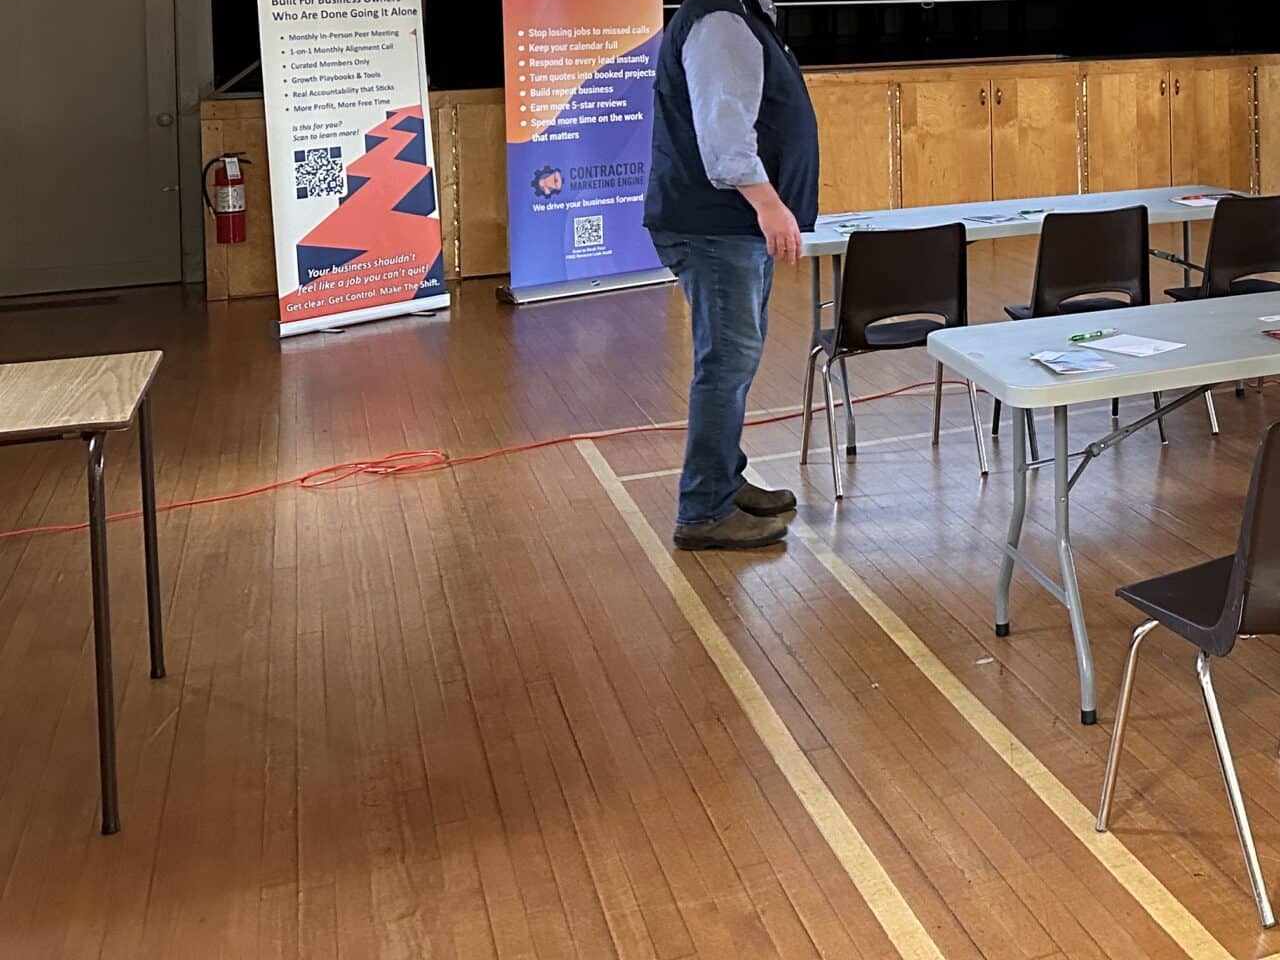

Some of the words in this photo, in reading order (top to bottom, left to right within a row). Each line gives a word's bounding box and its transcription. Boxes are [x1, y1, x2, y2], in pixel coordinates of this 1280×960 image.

[273, 11, 298, 21] Who
[301, 11, 318, 19] Are
[321, 10, 348, 19] Done
[351, 9, 379, 19] Going
[382, 8, 389, 17] It
[391, 7, 417, 16] Alone
[528, 29, 547, 39] Stop
[549, 28, 572, 37] losing
[574, 27, 591, 38] jobs
[603, 26, 631, 34] missed
[632, 25, 650, 34] calls
[346, 45, 380, 53] Alignment
[529, 44, 549, 54] Keep
[550, 44, 568, 53] your
[569, 42, 603, 51] calendar
[605, 41, 618, 49] full
[291, 62, 317, 70] Curated
[530, 58, 563, 68] Respond
[565, 58, 573, 66] to
[575, 57, 597, 67] every
[598, 56, 615, 65] lead
[617, 54, 649, 65] instantly
[320, 74, 354, 82] Playbooks
[530, 74, 548, 82] Turn
[549, 73, 575, 82] quotes
[578, 71, 593, 80] into
[595, 70, 623, 80] booked
[625, 69, 656, 79] projects
[310, 88, 359, 97] Accountability
[530, 88, 550, 97] Build
[552, 88, 577, 97] repeat
[578, 85, 614, 94] business
[531, 104, 549, 112] Earn
[550, 102, 570, 111] more
[572, 101, 595, 110] 5-star
[597, 99, 627, 109] reviews
[301, 124, 312, 132] this
[313, 122, 327, 132] for
[328, 121, 343, 130] you?
[531, 118, 556, 128] Spend
[558, 118, 577, 126] more
[579, 115, 596, 125] time
[610, 114, 623, 122] the
[624, 112, 643, 121] work
[293, 134, 309, 142] Scan
[319, 131, 338, 140] learn
[339, 129, 360, 138] more!
[532, 133, 548, 142] that
[550, 132, 579, 141] matters
[570, 162, 644, 180] CONTRACTOR
[570, 178, 616, 191] MARKETING
[618, 176, 644, 186] ENGINE
[533, 204, 545, 212] We
[547, 202, 564, 210] drive
[566, 202, 582, 211] your
[583, 198, 614, 208] business
[616, 194, 644, 204] forward
[308, 267, 329, 278] Your
[333, 262, 371, 275] business
[375, 254, 416, 266] shouldn't
[297, 281, 317, 296] feel
[318, 279, 335, 290] like
[338, 280, 344, 288] a
[346, 275, 362, 288] job
[364, 274, 381, 285] you
[383, 268, 405, 281] can't
[407, 264, 429, 278] quit!
[287, 302, 302, 313] Get
[304, 299, 326, 310] clear.
[329, 295, 344, 306] Get
[380, 285, 402, 296] Make
[404, 282, 418, 292] The
[420, 278, 440, 289] Shift.
